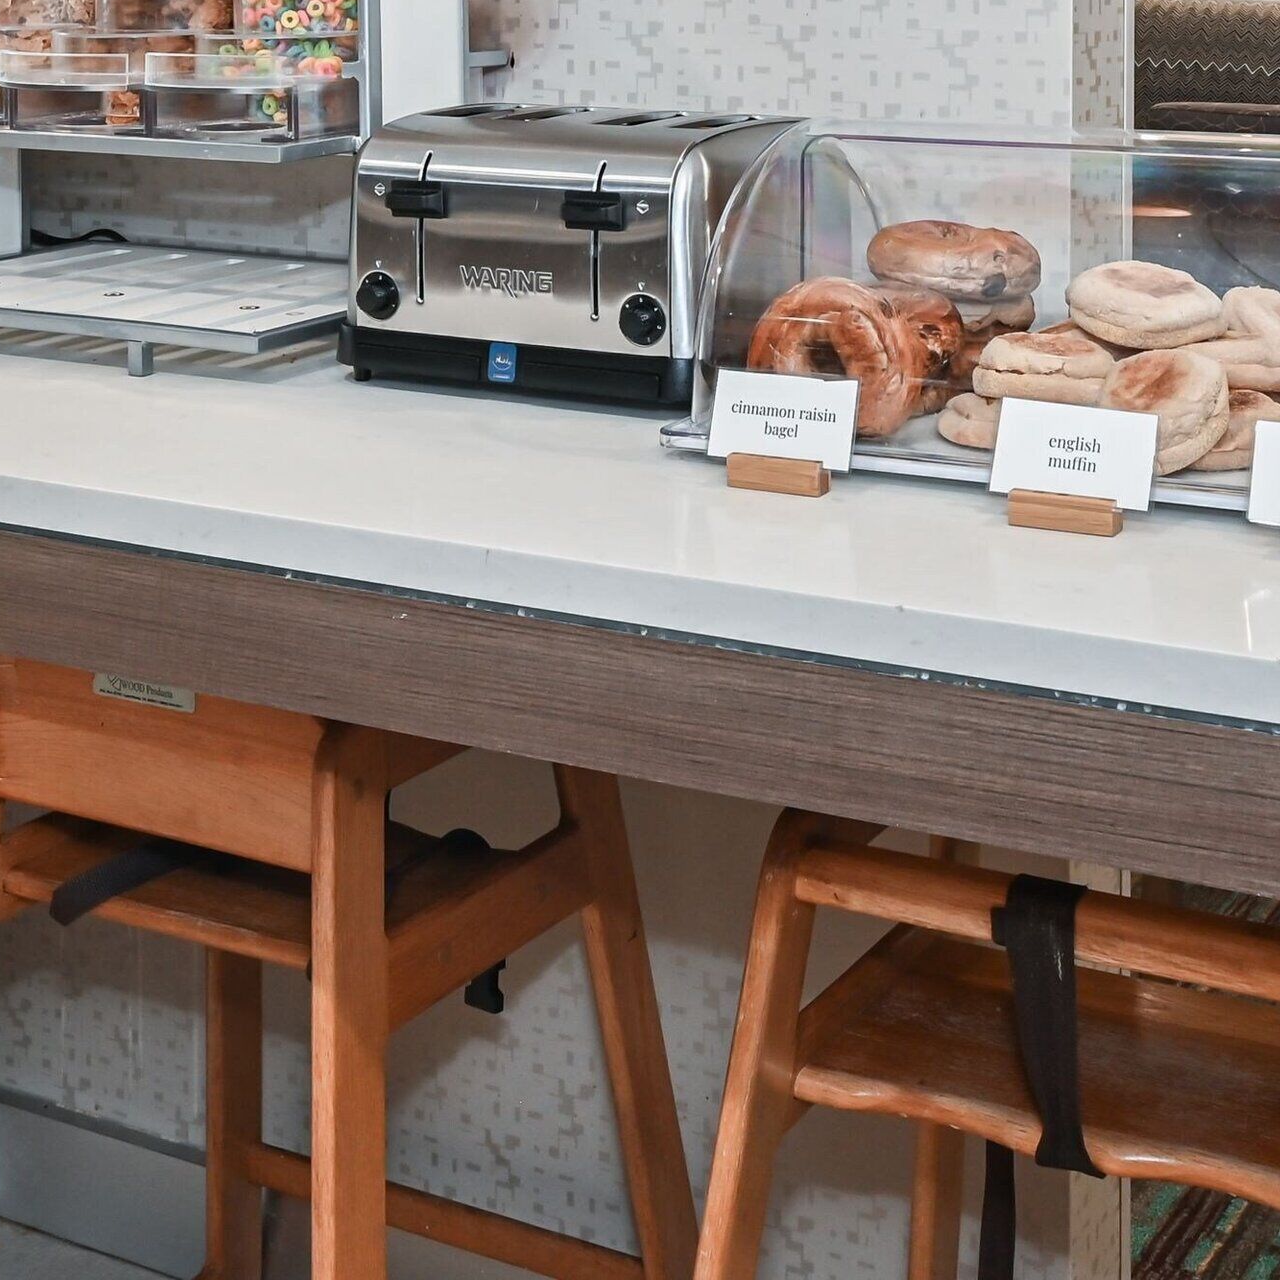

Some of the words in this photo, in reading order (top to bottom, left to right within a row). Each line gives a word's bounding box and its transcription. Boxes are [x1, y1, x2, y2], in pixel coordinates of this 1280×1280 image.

[459, 265, 553, 298] WARING
[731, 400, 795, 419] cinnamon
[799, 407, 837, 423] raisin
[764, 421, 799, 439] bagel
[1048, 434, 1102, 454] english
[1048, 454, 1098, 473] muffin
